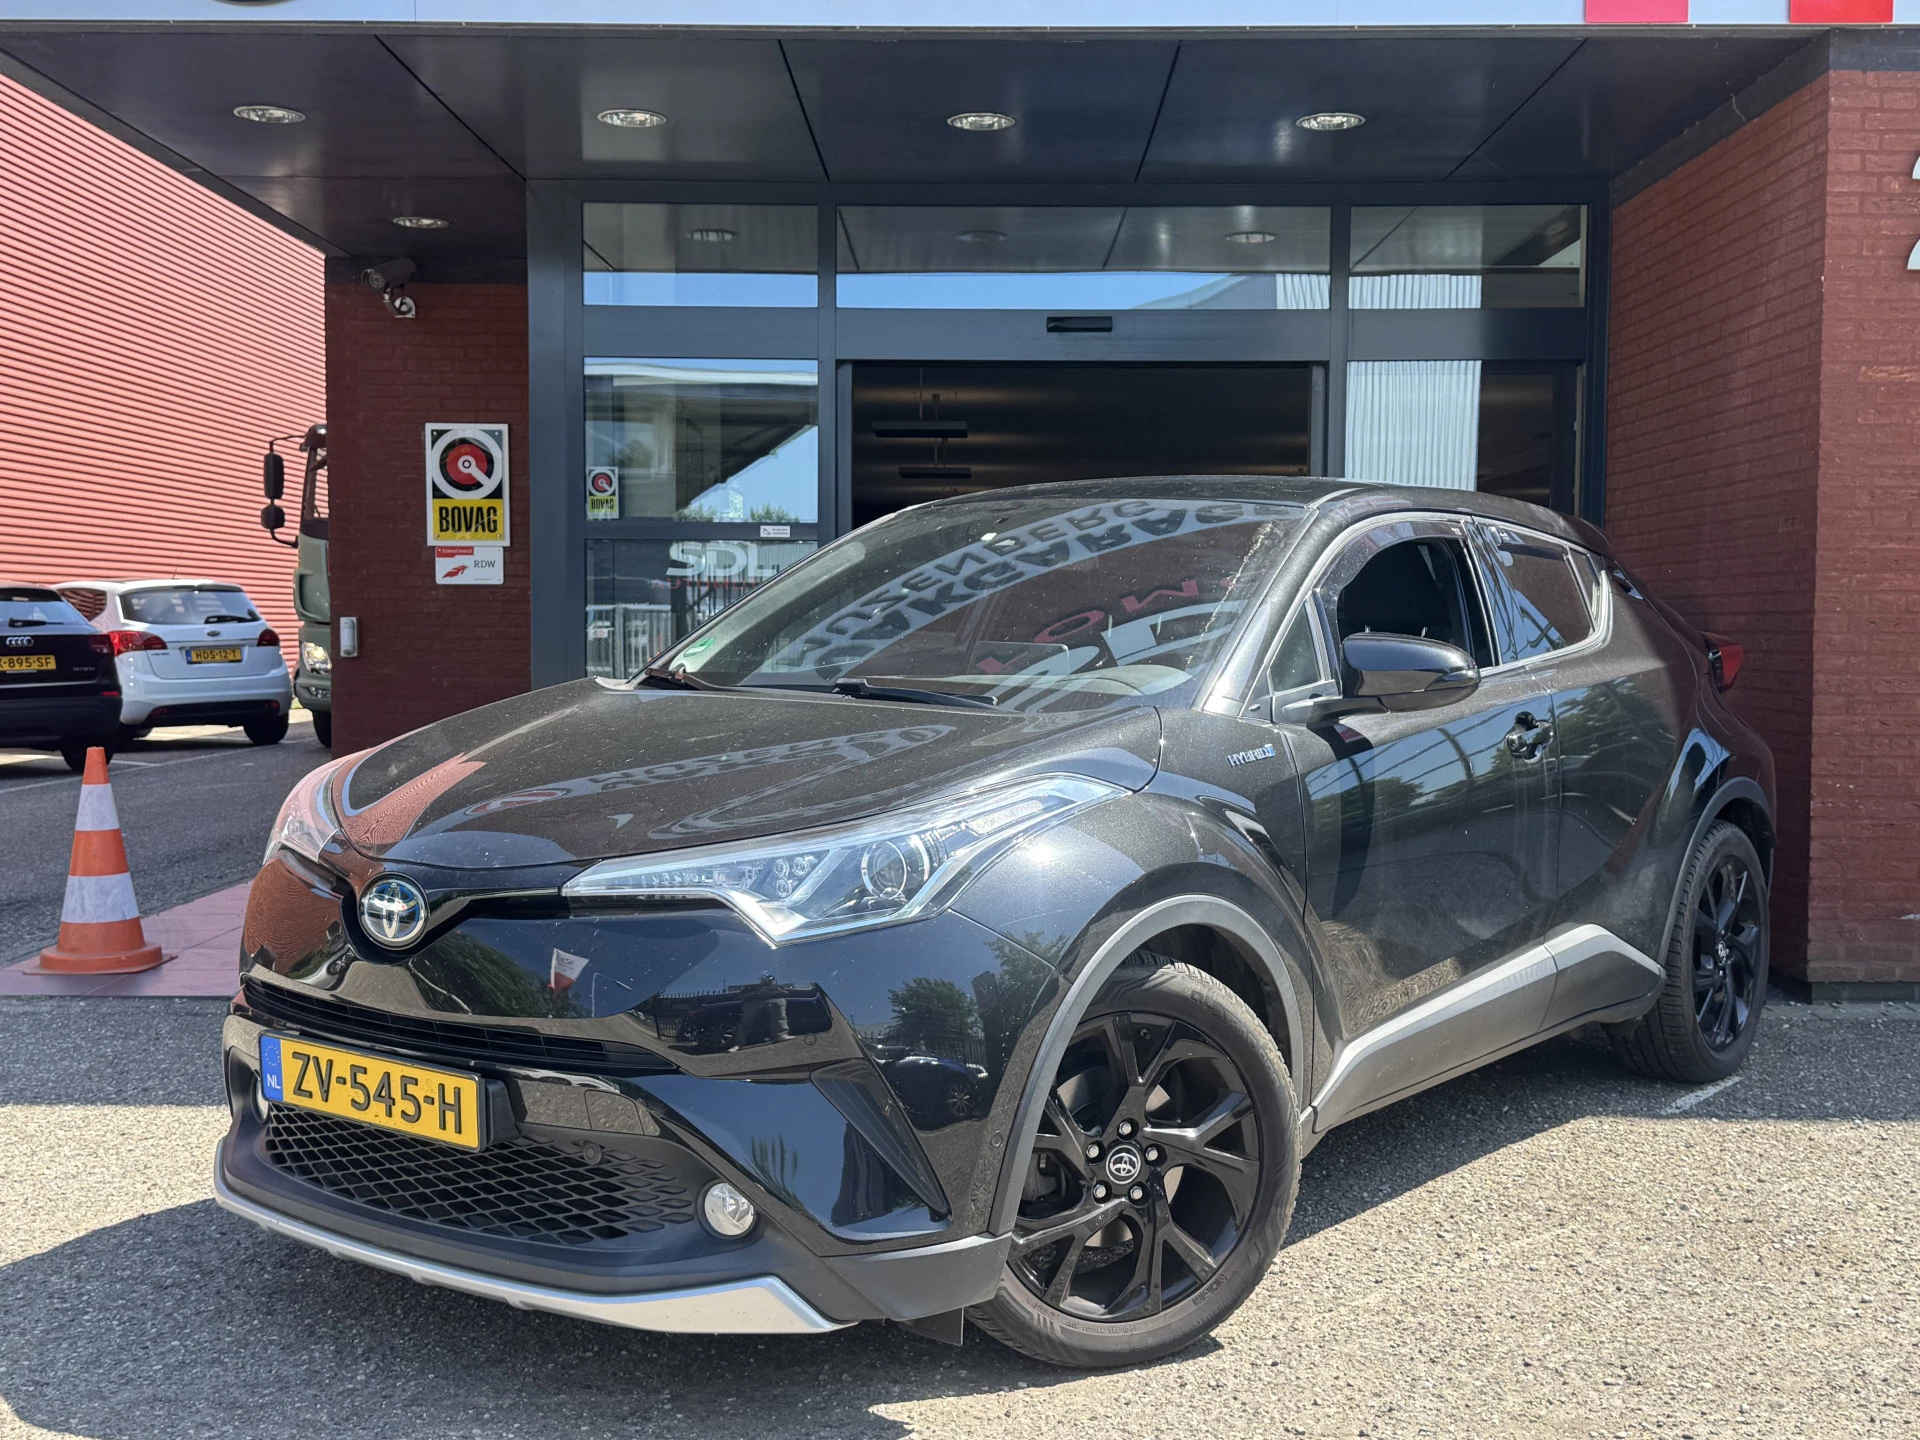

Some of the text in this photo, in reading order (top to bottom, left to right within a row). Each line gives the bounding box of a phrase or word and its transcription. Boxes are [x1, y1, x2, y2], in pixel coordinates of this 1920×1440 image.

[591, 498, 614, 510] BOVAG
[438, 505, 498, 534] BOVAG
[474, 560, 496, 569] RDW
[665, 542, 777, 577] SDL
[266, 1051, 462, 1135] NL ZV-545-H
